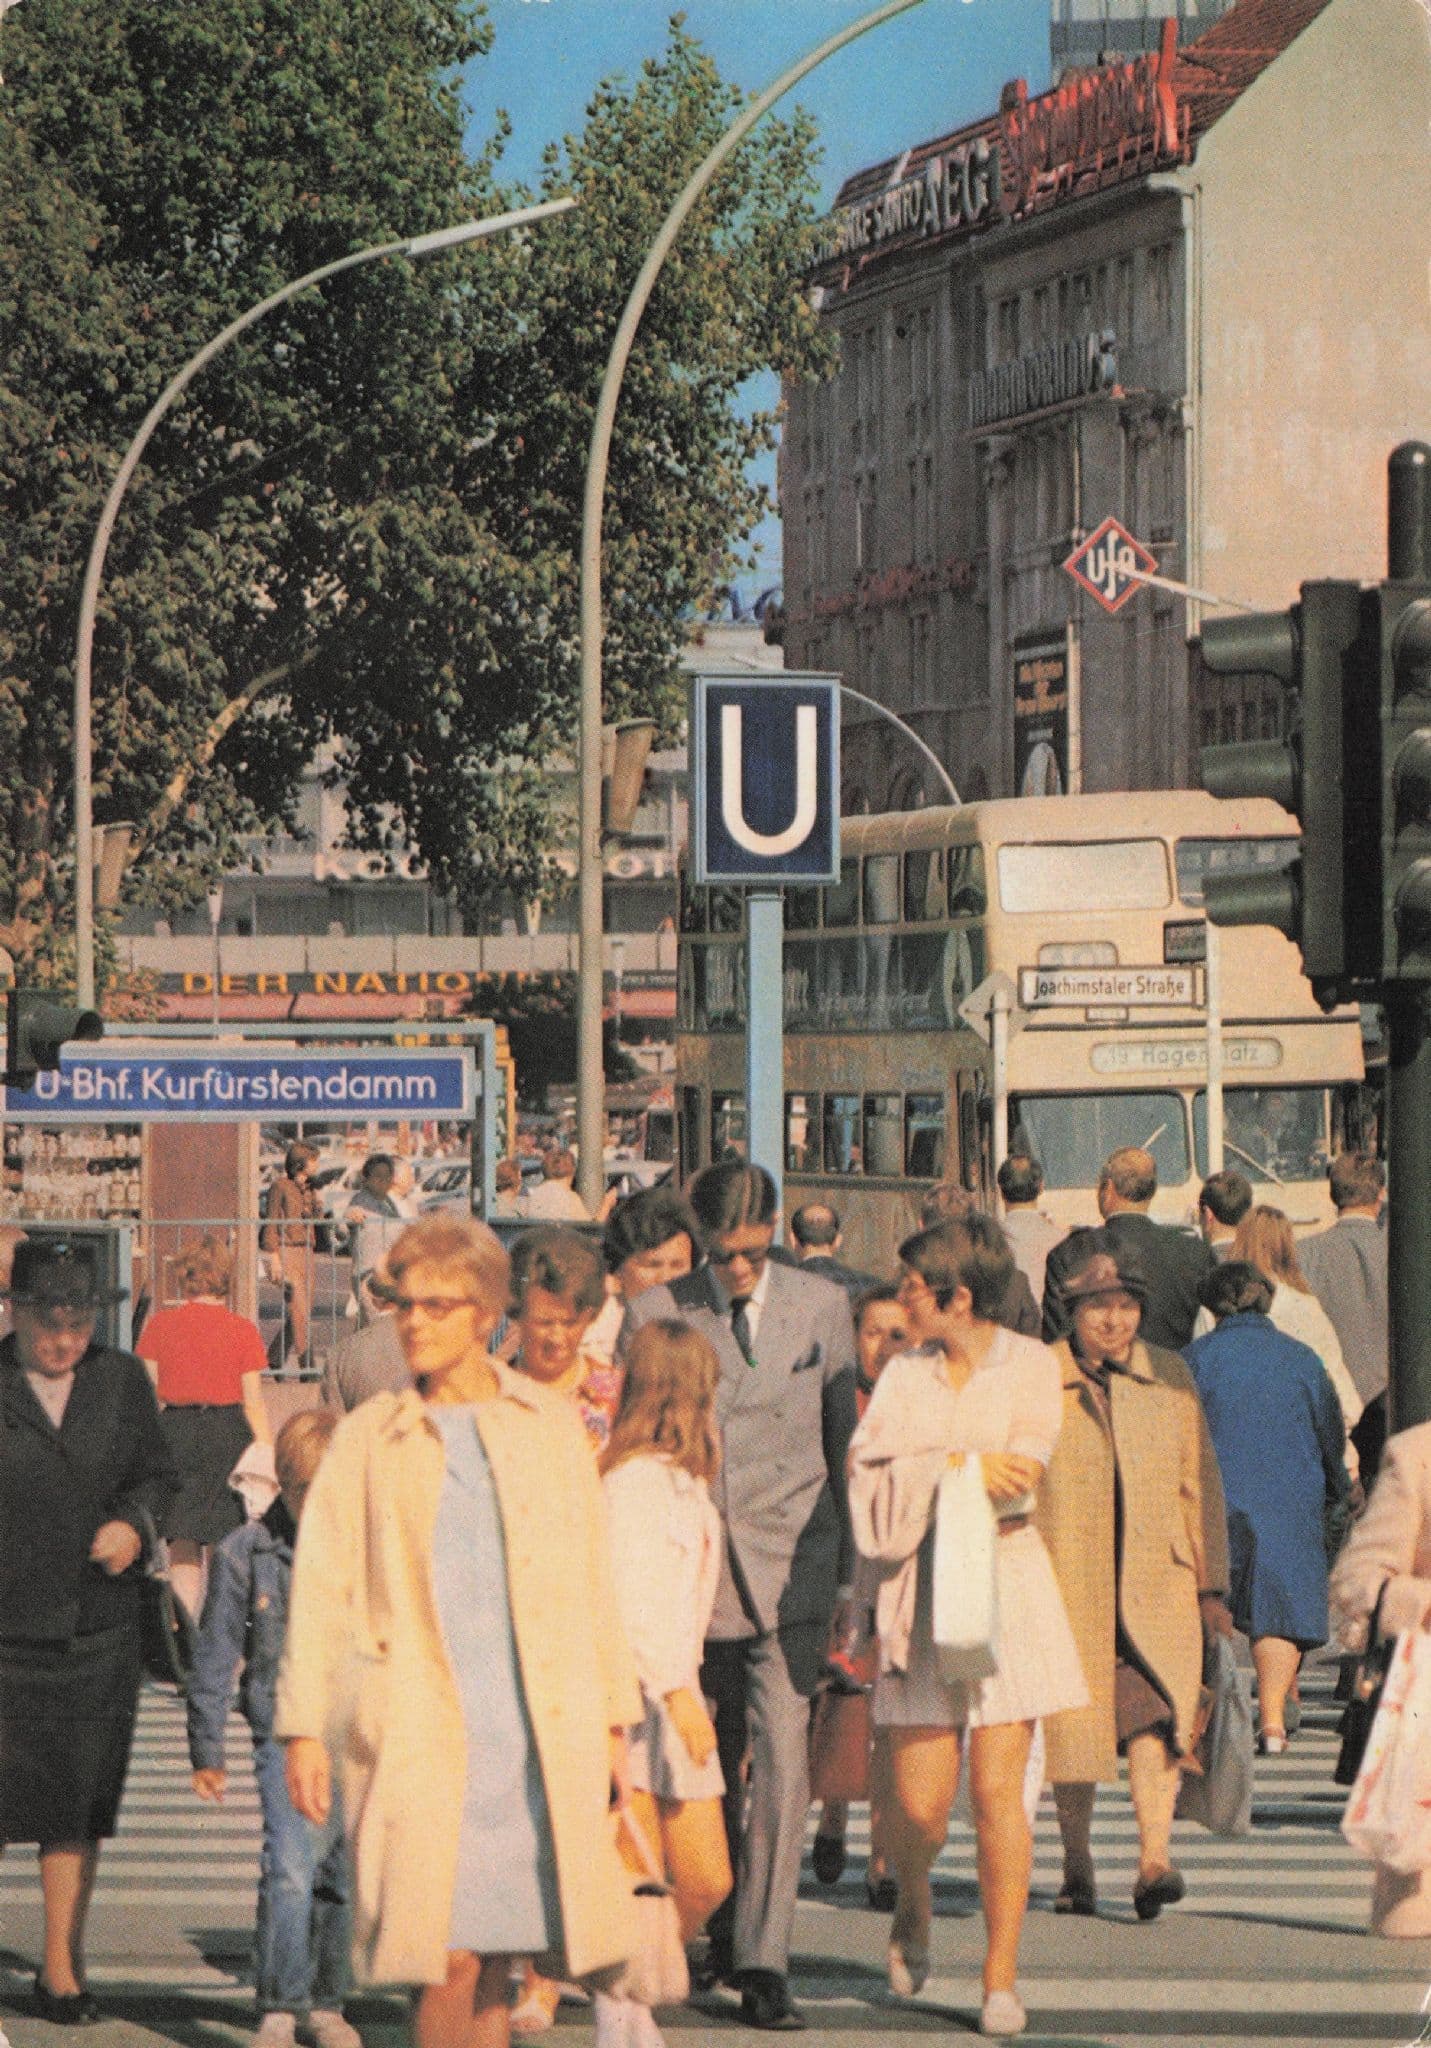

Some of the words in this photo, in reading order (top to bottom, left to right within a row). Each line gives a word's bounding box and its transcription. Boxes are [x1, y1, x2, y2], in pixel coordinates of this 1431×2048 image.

[921, 137, 990, 238] AEG
[721, 704, 817, 857] U
[183, 972, 288, 993] DER
[1033, 975, 1132, 1000] Joachimstaler
[1136, 975, 1185, 998] Straße
[1141, 1042, 1259, 1069] Hagenlatz
[142, 1066, 437, 1100] Kurfürstendamm
